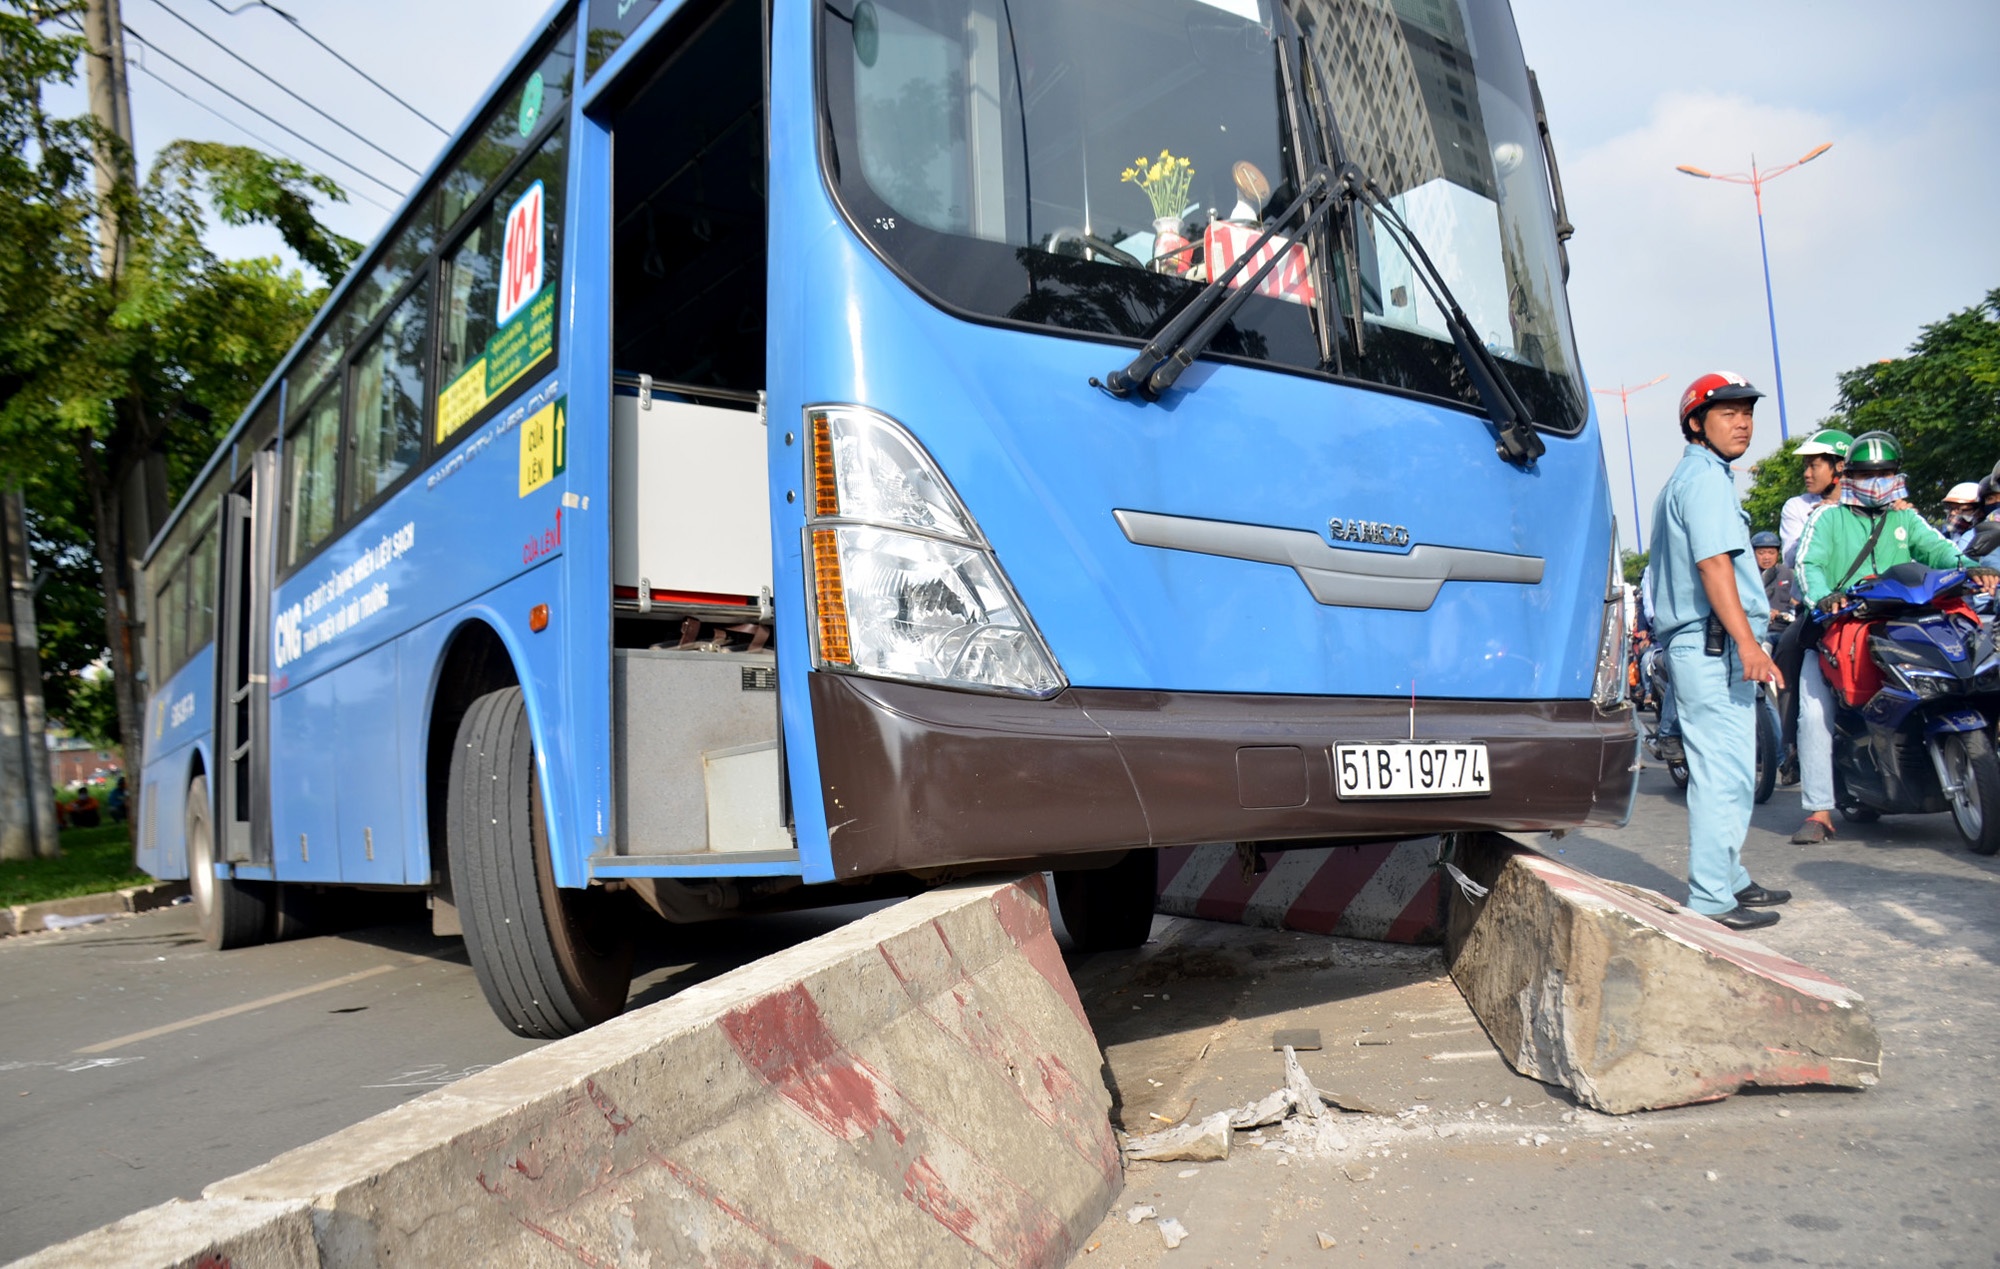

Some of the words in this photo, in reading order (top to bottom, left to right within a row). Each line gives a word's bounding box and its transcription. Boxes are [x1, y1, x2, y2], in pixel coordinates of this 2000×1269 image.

[507, 193, 538, 313] 104
[1213, 225, 1316, 306] 104
[528, 456, 543, 486] LÊN
[1329, 517, 1409, 547] SAMCO
[275, 602, 302, 669] CNG
[1341, 749, 1485, 790] 51B-197.74
